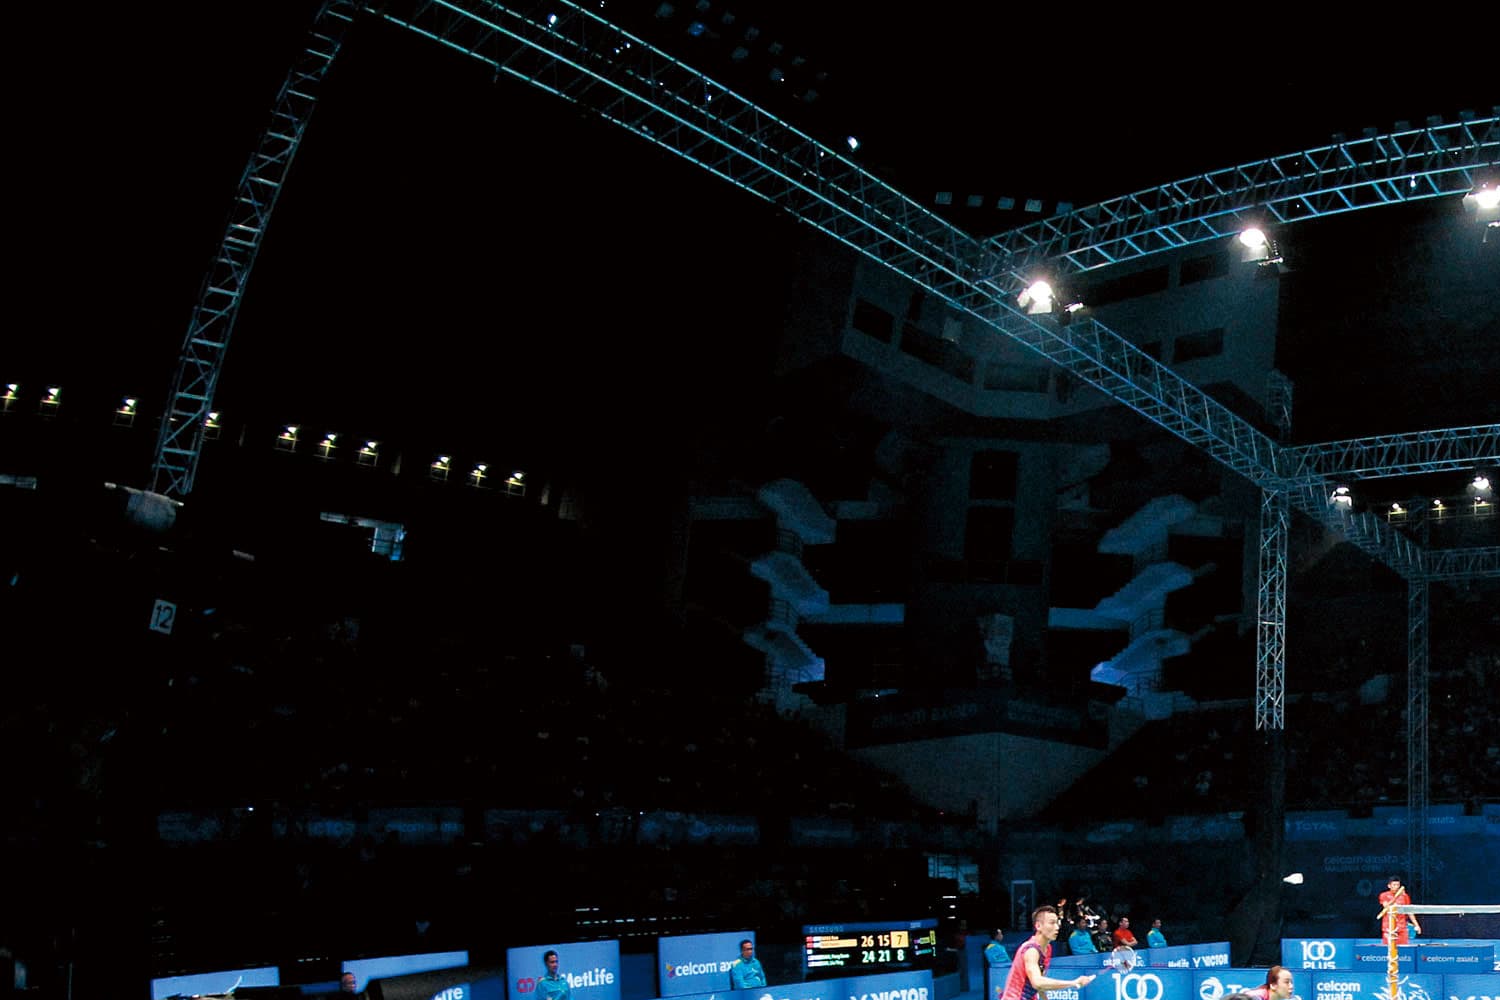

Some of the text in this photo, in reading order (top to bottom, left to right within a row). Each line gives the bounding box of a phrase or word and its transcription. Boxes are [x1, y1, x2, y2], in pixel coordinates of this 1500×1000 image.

[156, 605, 173, 629] 12
[860, 935, 875, 948] 26
[877, 934, 890, 947] 15
[897, 934, 903, 946] 7
[861, 950, 875, 964] 24
[878, 950, 890, 963] 21
[896, 949, 905, 962] 8
[1301, 941, 1336, 961] 100
[675, 961, 717, 977] celcom
[1303, 961, 1336, 970] PLUS
[1316, 980, 1361, 992] celcom
[1046, 988, 1079, 1000] axiata
